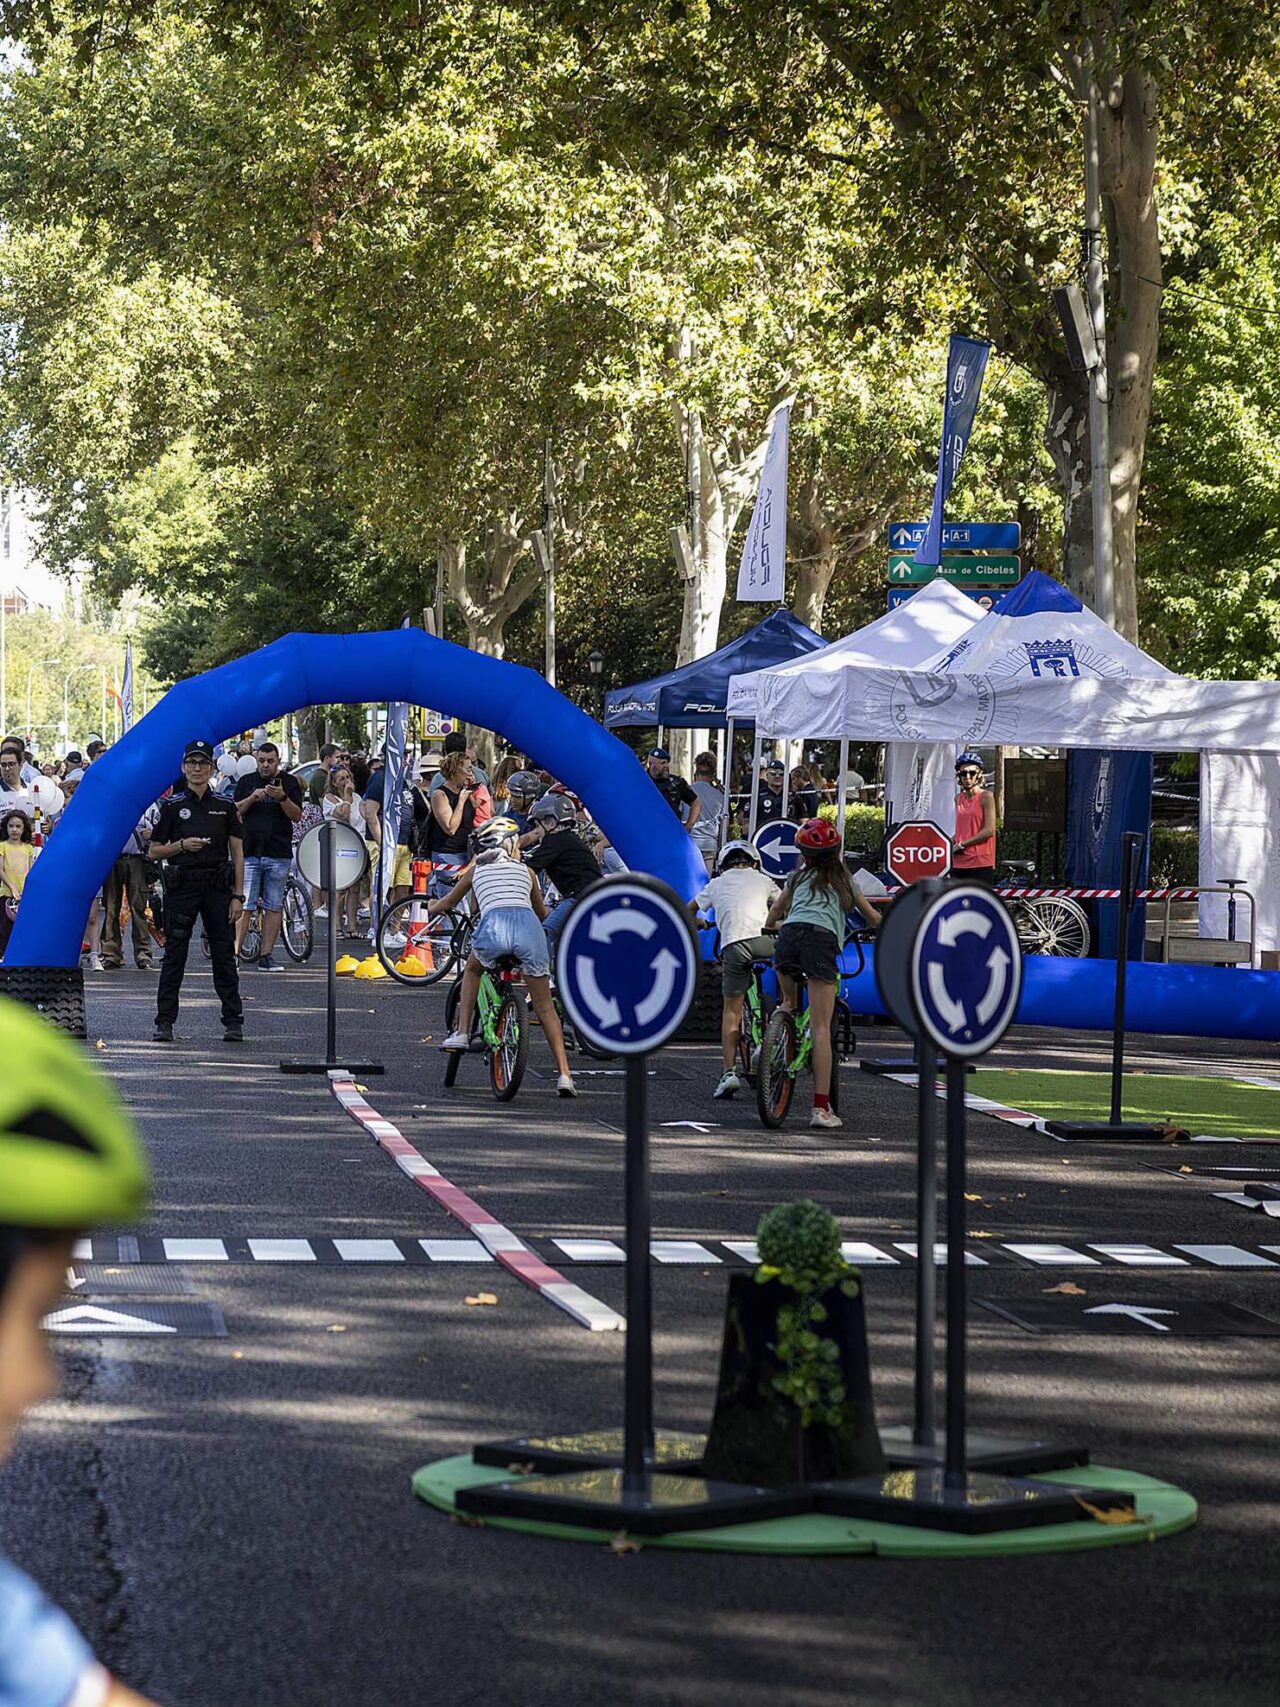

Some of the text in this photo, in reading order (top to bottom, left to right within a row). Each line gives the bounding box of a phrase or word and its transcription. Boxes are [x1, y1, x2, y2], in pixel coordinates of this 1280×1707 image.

[952, 532, 968, 540] A-1
[975, 565, 1015, 574] Cibeles
[892, 846, 946, 863] STOP
